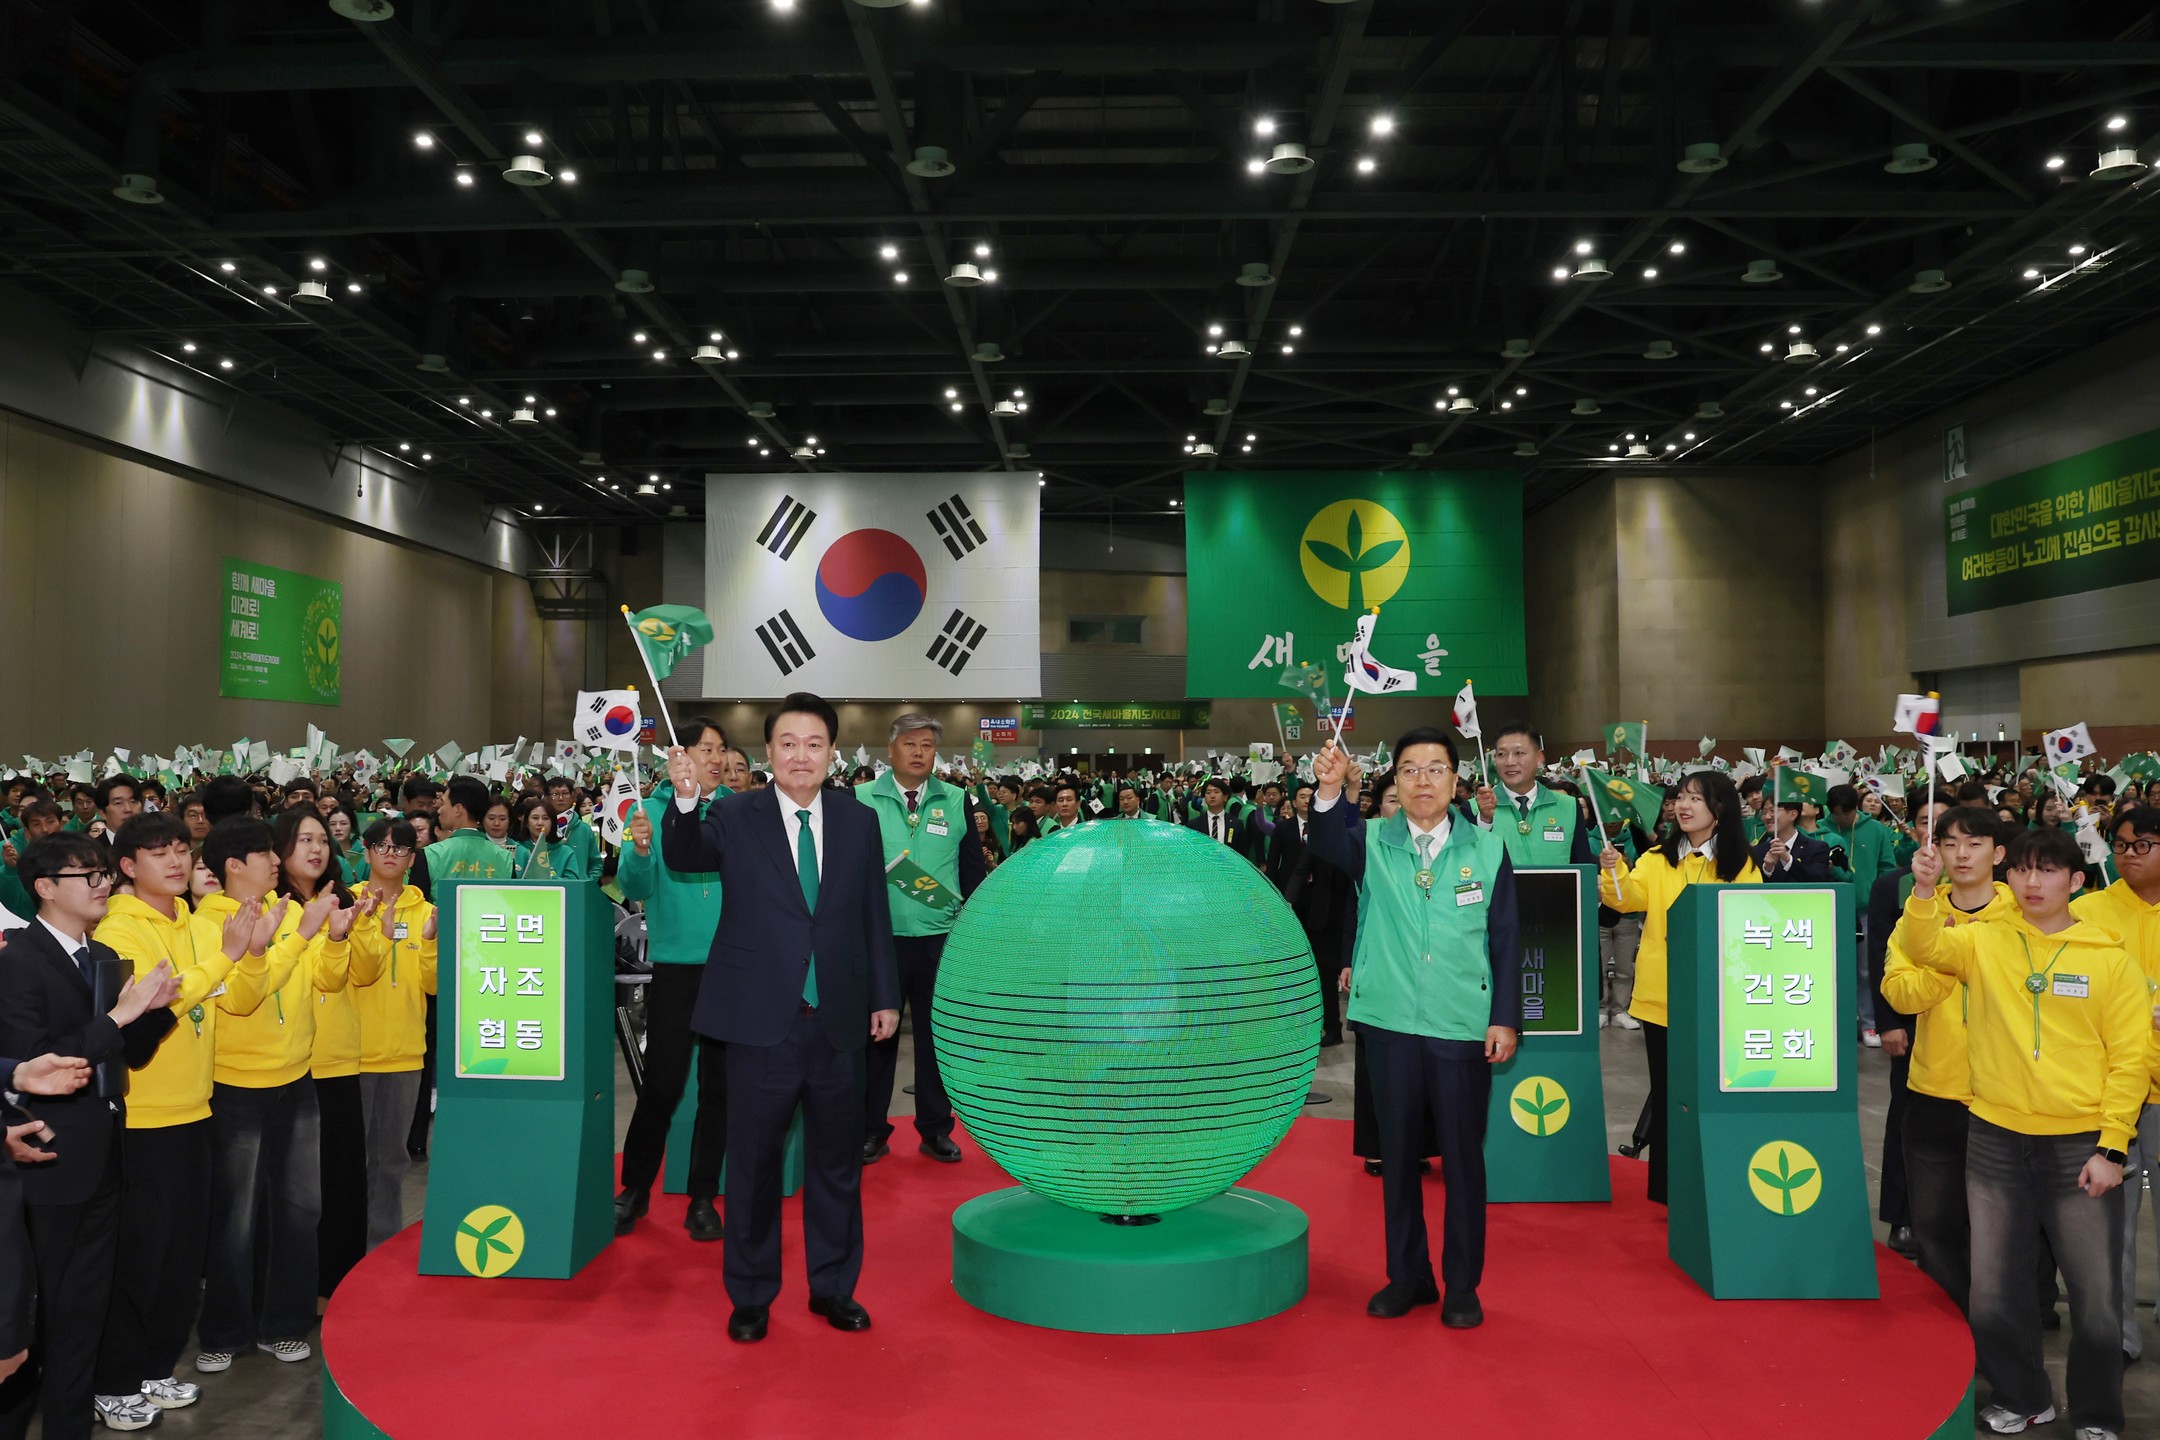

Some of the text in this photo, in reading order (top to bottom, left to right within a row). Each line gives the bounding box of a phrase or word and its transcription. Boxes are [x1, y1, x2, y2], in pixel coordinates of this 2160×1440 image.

[1990, 499, 2053, 539] 대한민국을
[2055, 490, 2085, 522] 위한
[1962, 544, 2019, 581] 여러분들의
[2022, 534, 2061, 568] 노고에
[2063, 520, 2122, 559] 진심으로
[231, 595, 260, 618] 미래로!
[230, 619, 260, 641] 세계로!
[1051, 709, 1080, 720] 2024
[1082, 708, 1181, 720] 전국새마을지도자대회
[480, 913, 544, 943] 근면
[1743, 919, 1813, 950] 녹색
[478, 966, 545, 996] 자조
[1521, 948, 1545, 1020] 새마을
[1743, 974, 1814, 1005] 건강
[478, 1018, 544, 1050] 협동
[1743, 1028, 1815, 1060] 문화
